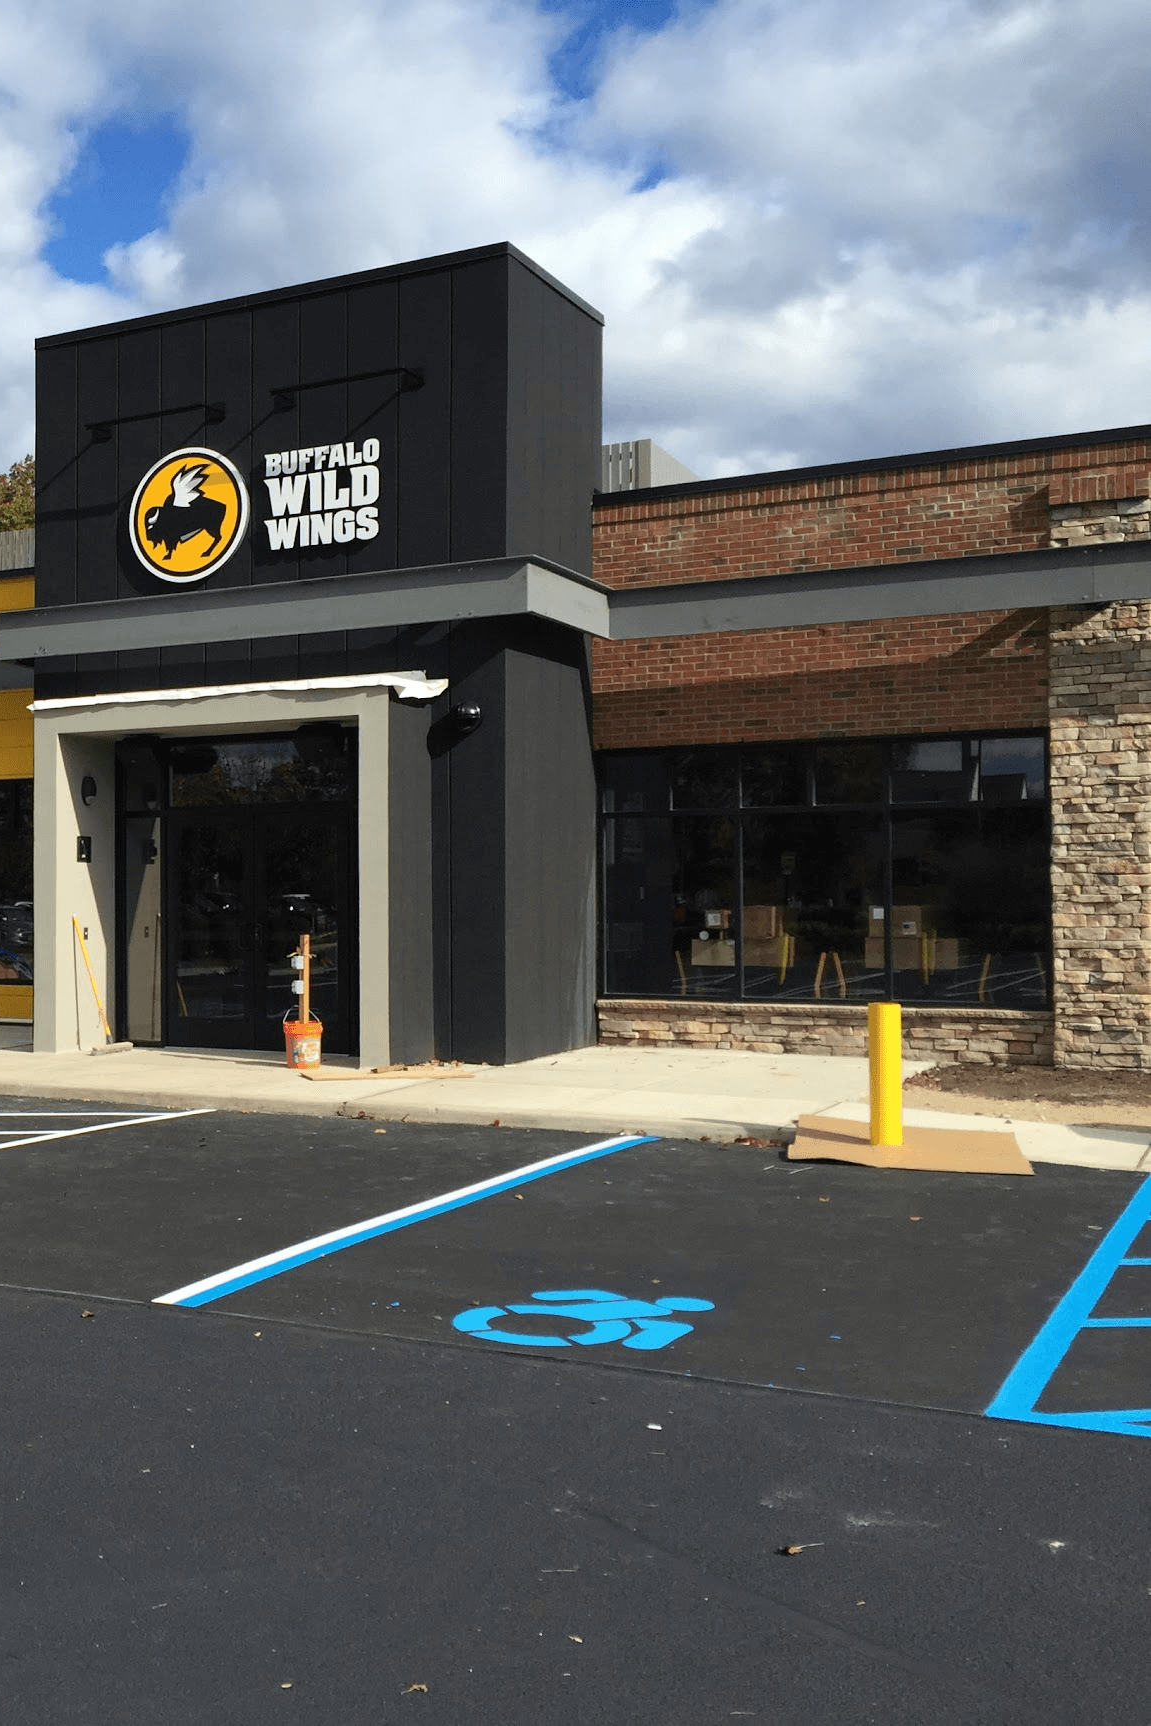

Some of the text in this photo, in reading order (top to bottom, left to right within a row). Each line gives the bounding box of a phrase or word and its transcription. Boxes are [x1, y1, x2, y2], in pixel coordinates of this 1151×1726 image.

[264, 438, 380, 477] BUFFALO
[263, 465, 380, 517] WILD
[263, 507, 380, 551] WINGS
